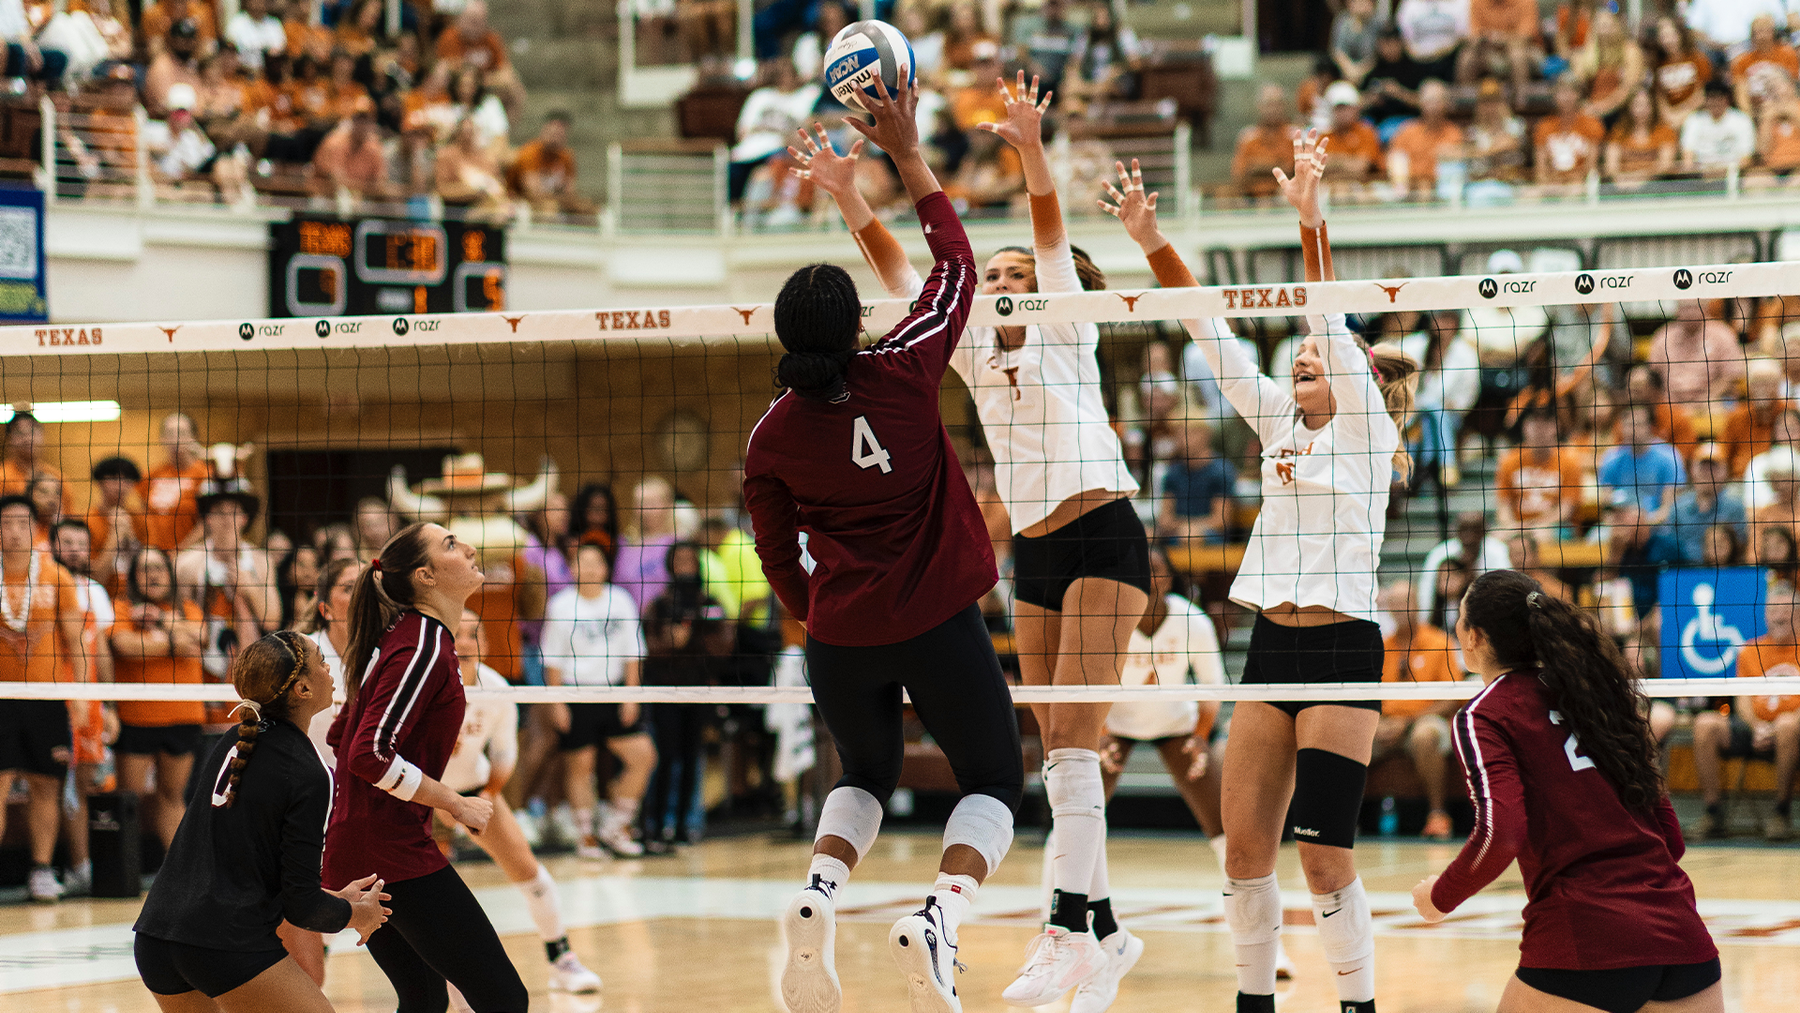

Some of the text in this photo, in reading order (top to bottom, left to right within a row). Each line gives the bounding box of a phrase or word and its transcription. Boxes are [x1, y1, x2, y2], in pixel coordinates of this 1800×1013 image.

[1600, 276, 1634, 289] razr
[1698, 271, 1734, 284] razr
[1503, 281, 1537, 293] razr
[1222, 287, 1308, 309] TEXAS
[1018, 299, 1049, 311] razr
[413, 320, 441, 332] razr
[595, 310, 672, 331] TEXAS
[258, 325, 285, 336] razr
[335, 322, 363, 334] razr
[34, 328, 103, 346] TEXAS
[851, 414, 893, 475] 4
